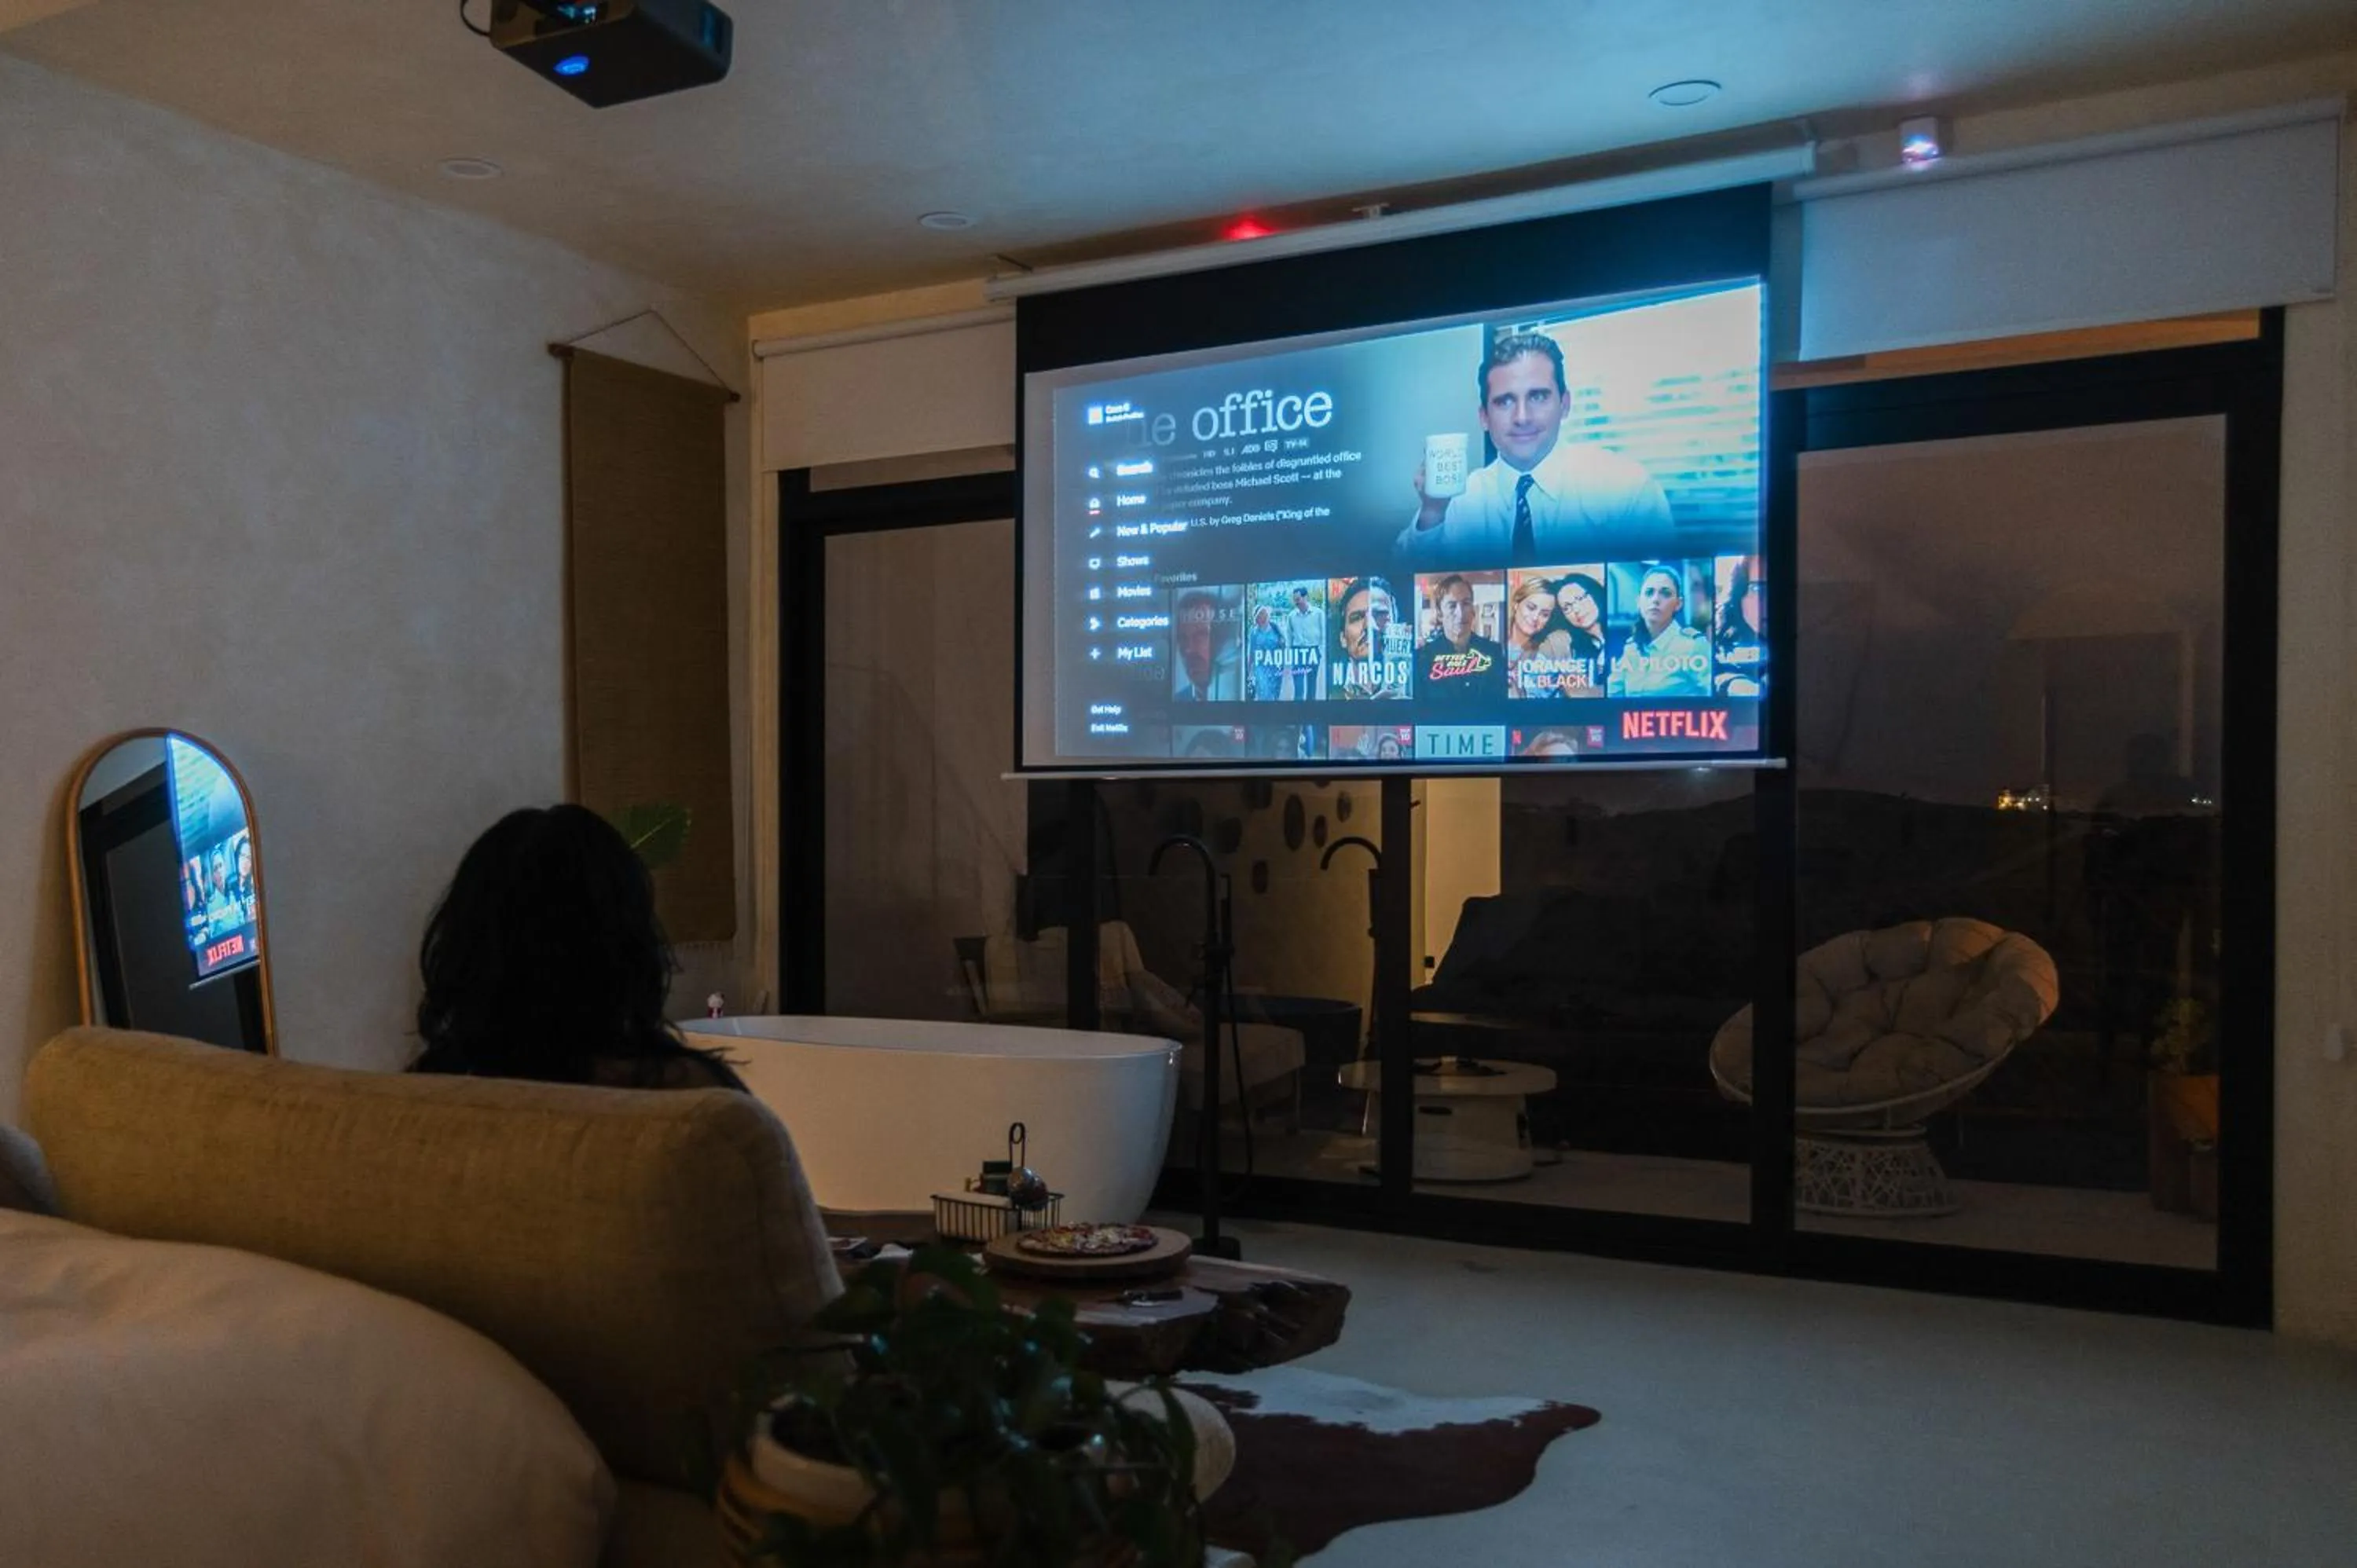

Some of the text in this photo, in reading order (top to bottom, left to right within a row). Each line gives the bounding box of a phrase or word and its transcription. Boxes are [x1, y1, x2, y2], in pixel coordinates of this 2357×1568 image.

[1192, 390, 1333, 441] office
[1215, 465, 1231, 475] the
[1264, 459, 1275, 471] of
[1276, 452, 1331, 470] disgruntled
[1333, 450, 1362, 463] office
[1211, 479, 1234, 491] boss
[1234, 474, 1273, 489] Michael
[1273, 471, 1299, 485] Scott
[1313, 470, 1324, 481] at
[1325, 467, 1342, 479] the
[1116, 494, 1147, 507] Home
[1208, 515, 1221, 528] by
[1220, 512, 1243, 526] Greg
[1303, 506, 1314, 518] of
[1314, 505, 1331, 517] the
[1116, 584, 1153, 598] Movies
[1116, 614, 1170, 629] Categories
[1116, 646, 1153, 661] My List
[1255, 647, 1319, 669] PAQUITA
[1611, 655, 1635, 673] LA
[1332, 661, 1409, 686] NARCOS
[1430, 656, 1478, 680] Saul
[1523, 658, 1587, 673] ORANGE
[1538, 673, 1588, 688] BLACK
[1622, 711, 1727, 739] NETFLIX
[1426, 733, 1494, 755] TIME
